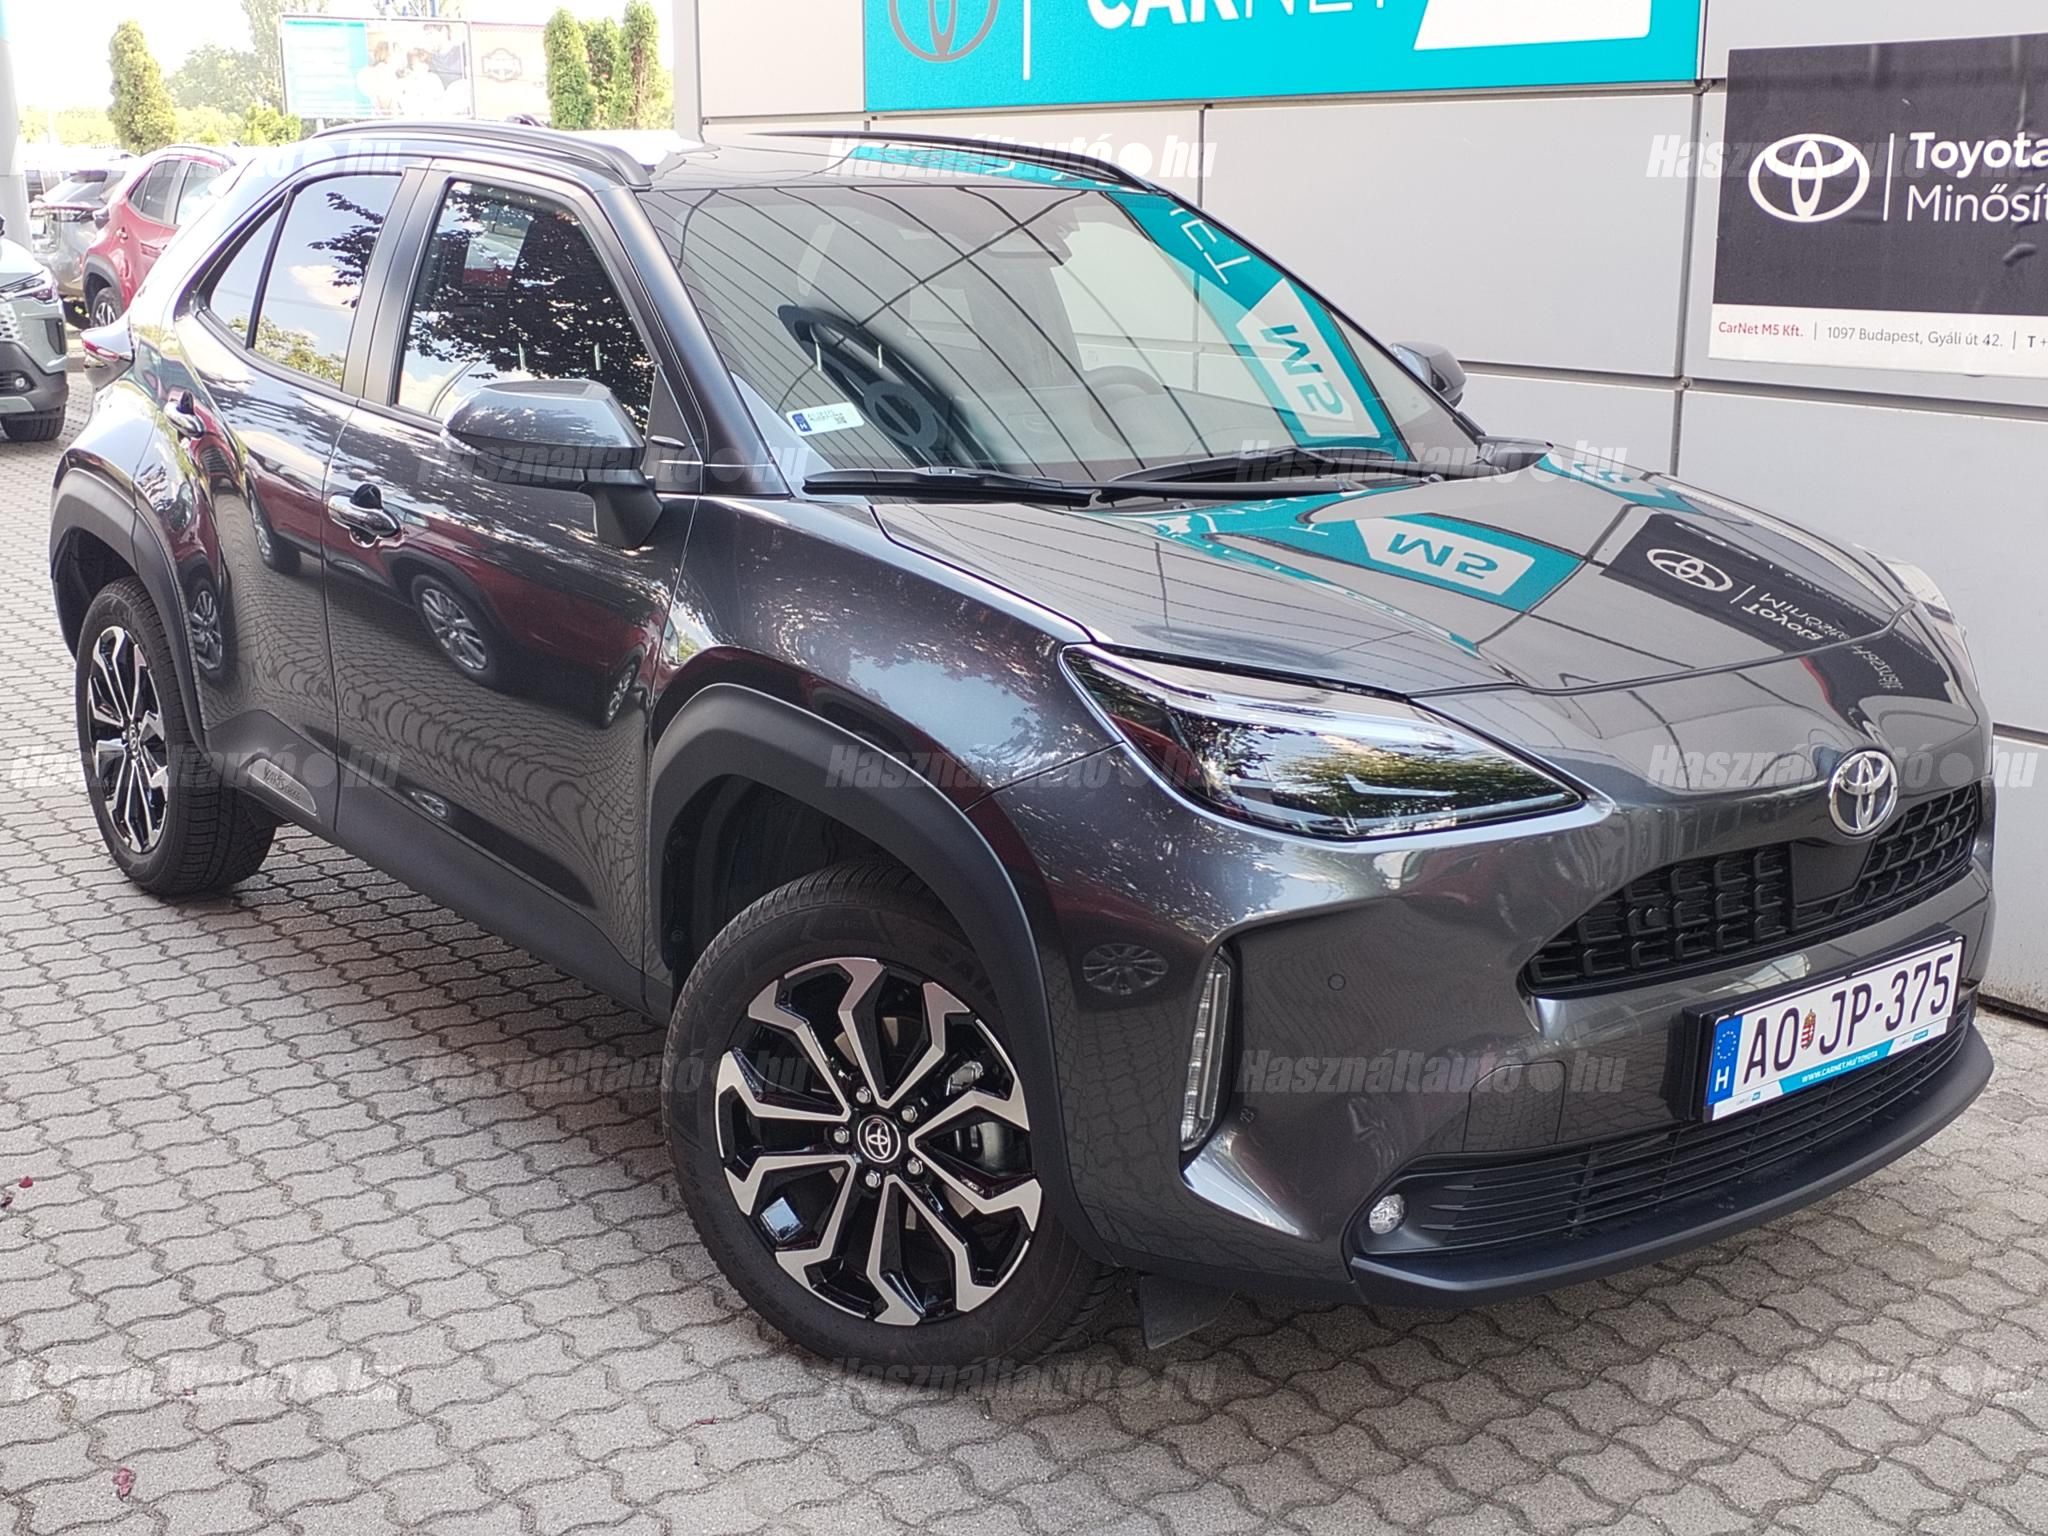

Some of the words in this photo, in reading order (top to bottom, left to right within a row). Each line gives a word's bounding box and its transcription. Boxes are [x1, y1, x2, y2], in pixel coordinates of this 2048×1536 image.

[1909, 131, 2048, 179] Toyota
[1718, 321, 1758, 335] CarNet
[1761, 323, 1779, 336] M5
[1782, 325, 1804, 338] Kft.
[1827, 326, 1856, 339] 1097
[1858, 328, 1924, 345] Budapest,
[1927, 330, 1962, 348] Gyáli
[1965, 332, 1979, 346] út
[1982, 333, 2004, 347] 42.
[1714, 1066, 1730, 1093] H
[1743, 1007, 1800, 1085] AO
[1818, 953, 1954, 1056] JP-375
